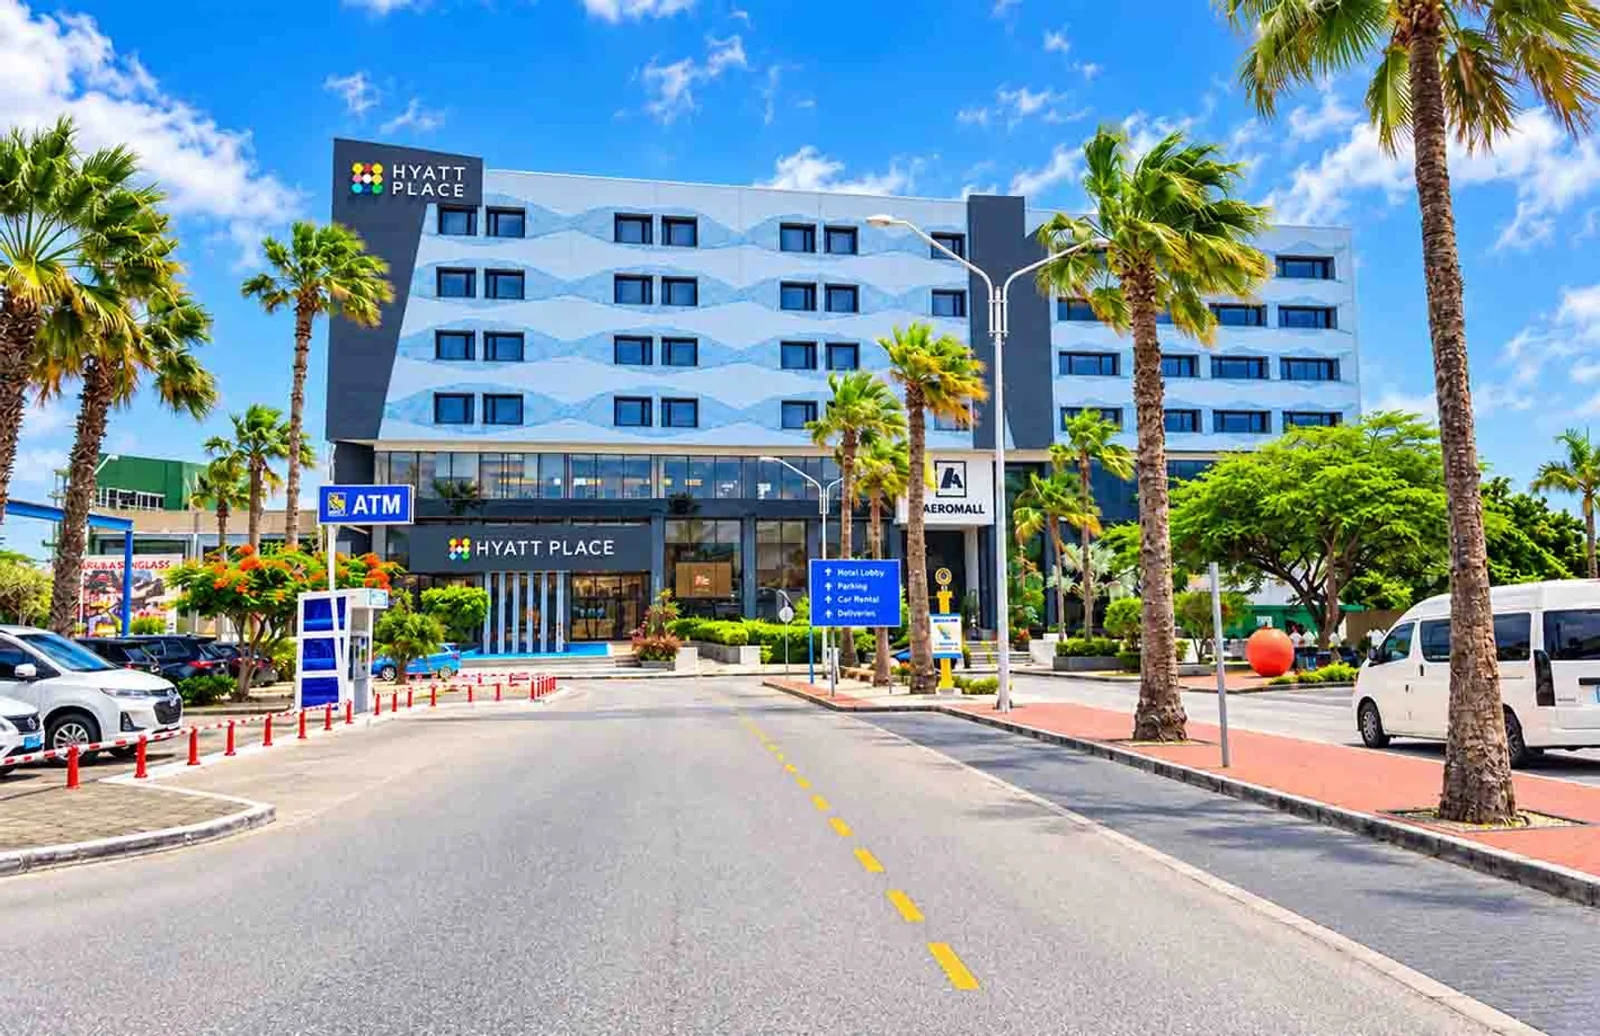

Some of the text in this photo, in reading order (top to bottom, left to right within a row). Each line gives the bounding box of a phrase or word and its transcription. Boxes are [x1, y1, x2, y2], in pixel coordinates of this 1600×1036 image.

[392, 165, 466, 181] HYATT
[392, 181, 464, 197] PLACE
[352, 494, 401, 515] ATM
[923, 503, 985, 514] AEROMALL
[476, 540, 615, 556] HYATT PLACE
[117, 560, 170, 570] SNGLASS
[837, 568, 885, 578] Hotel Lobby
[837, 582, 868, 592] Parking
[837, 595, 880, 604] Car Rental
[837, 609, 877, 618] Deliveries
